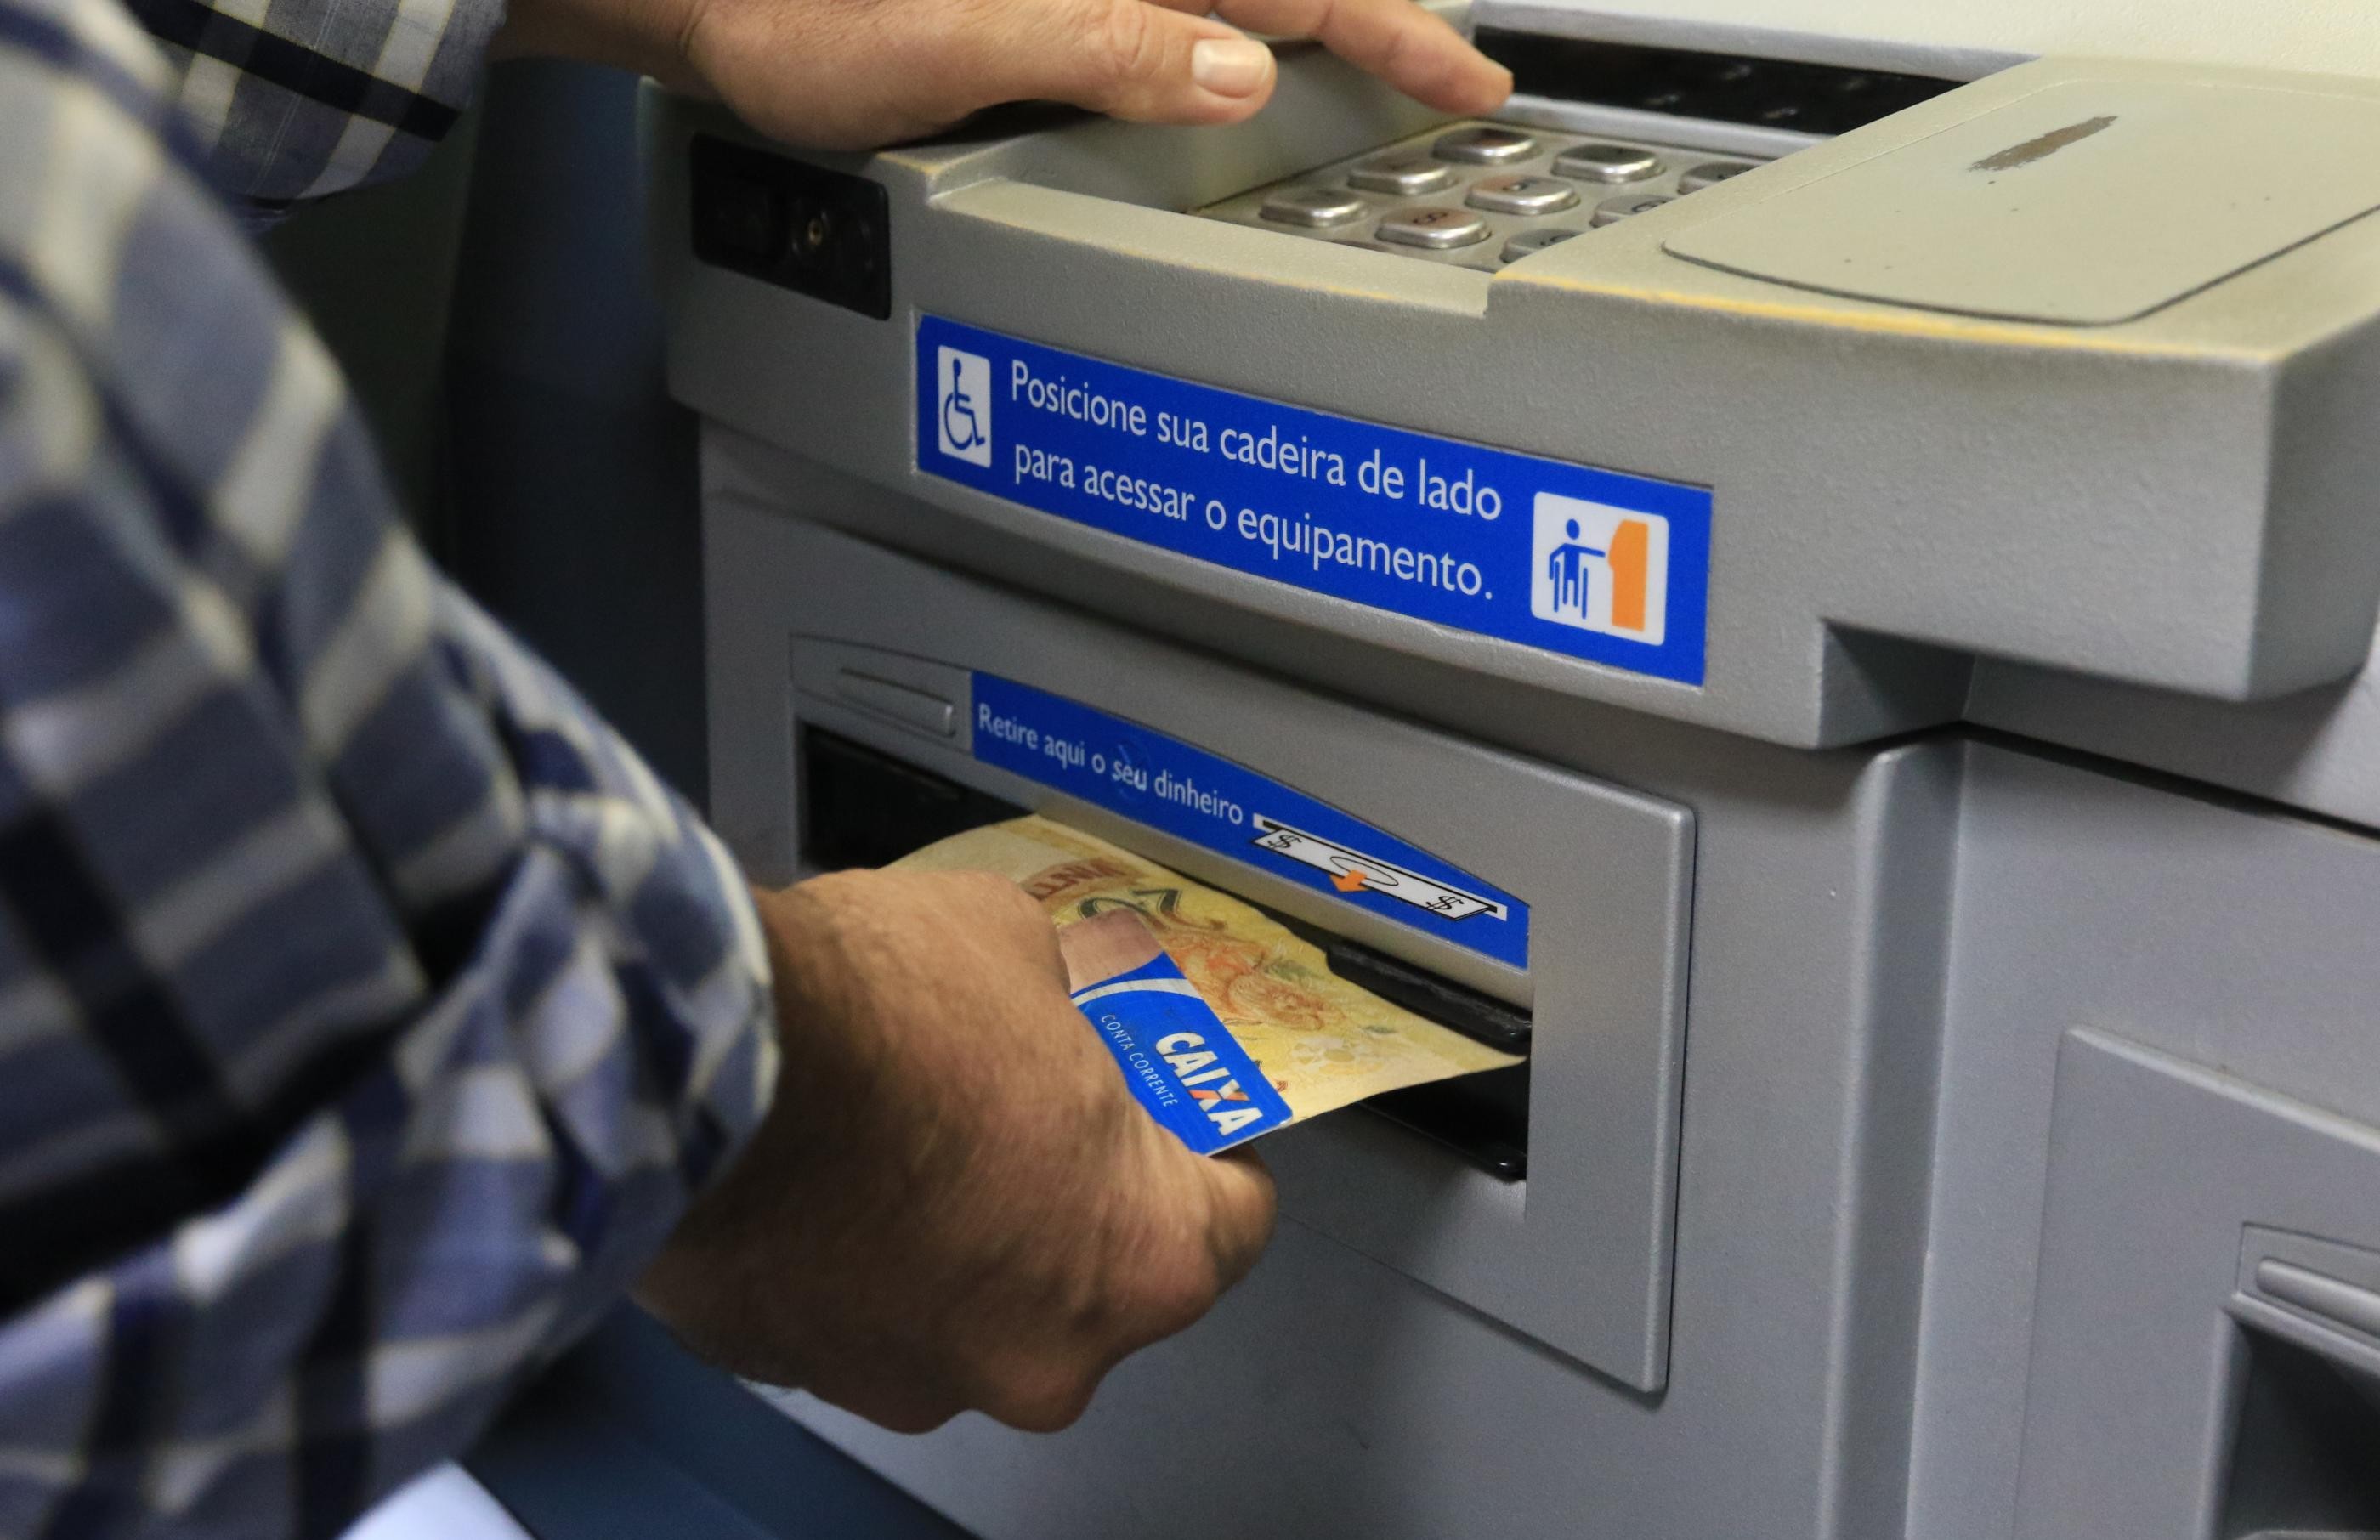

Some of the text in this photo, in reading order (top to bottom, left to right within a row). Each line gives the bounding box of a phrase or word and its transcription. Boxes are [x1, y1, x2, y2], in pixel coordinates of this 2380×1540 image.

[1012, 360, 1503, 521] Posicione sua cadeira de lado
[1014, 444, 1493, 600] para acessar o equipamento.
[978, 702, 1244, 825] Retire aqui o seu dinheiro
[1101, 1014, 1178, 1107] CONTA CORRENTE
[1155, 1032, 1263, 1136] CAIXA
